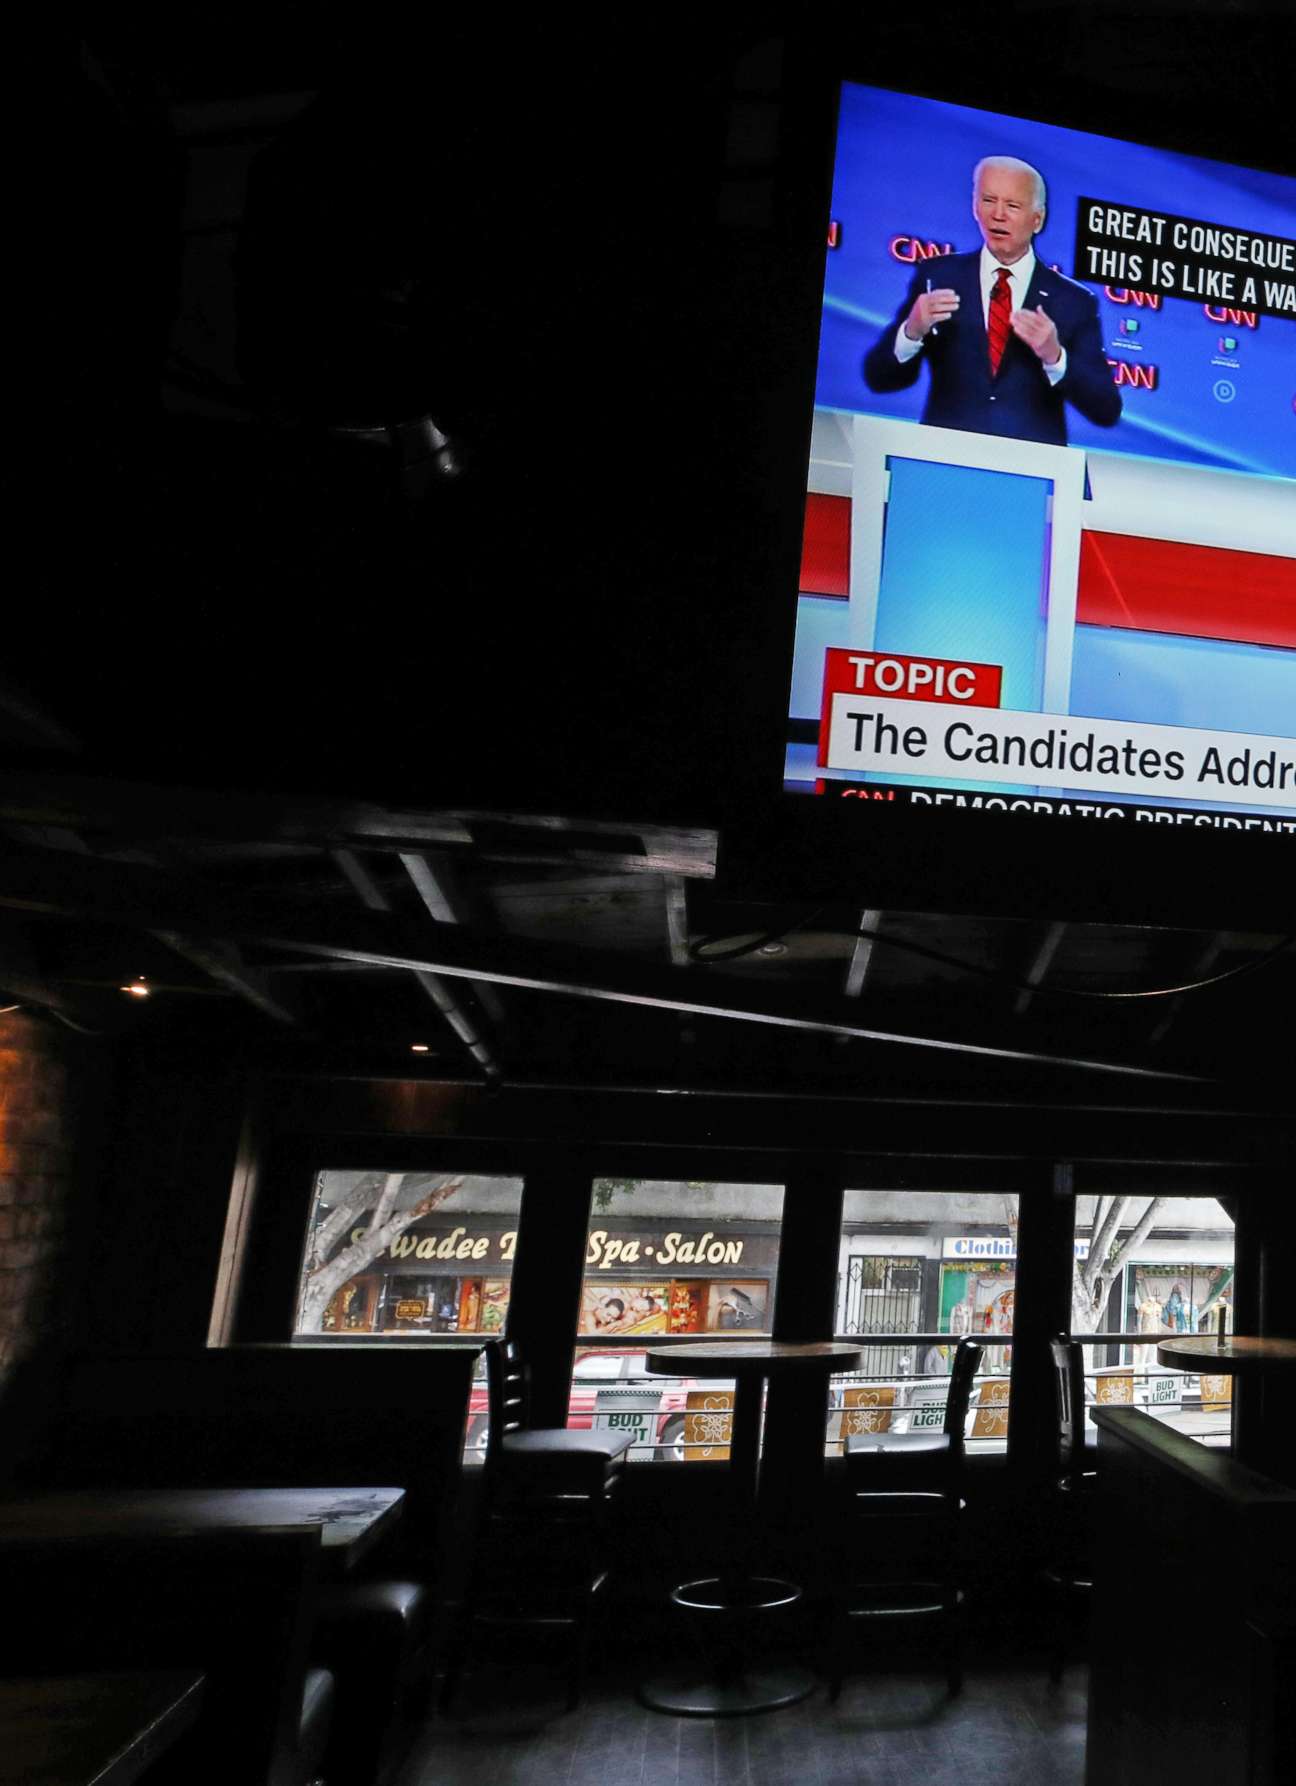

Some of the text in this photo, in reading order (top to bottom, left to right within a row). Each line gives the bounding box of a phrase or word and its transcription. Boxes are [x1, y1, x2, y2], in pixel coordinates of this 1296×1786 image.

[1087, 205, 1167, 246] GREAT
[1086, 245, 1143, 282] THIS
[1151, 259, 1176, 288] IS
[1182, 265, 1236, 300] LIKE
[1242, 277, 1257, 305] A
[848, 655, 976, 700] TOPIC
[846, 711, 928, 758] The
[943, 721, 1185, 781] Candidates
[586, 1230, 641, 1269] Spa
[1152, 1390, 1177, 1403] LIGHT
[1156, 1380, 1175, 1391] BUD
[608, 1413, 644, 1427] BUD
[912, 1414, 945, 1426] LIGH
